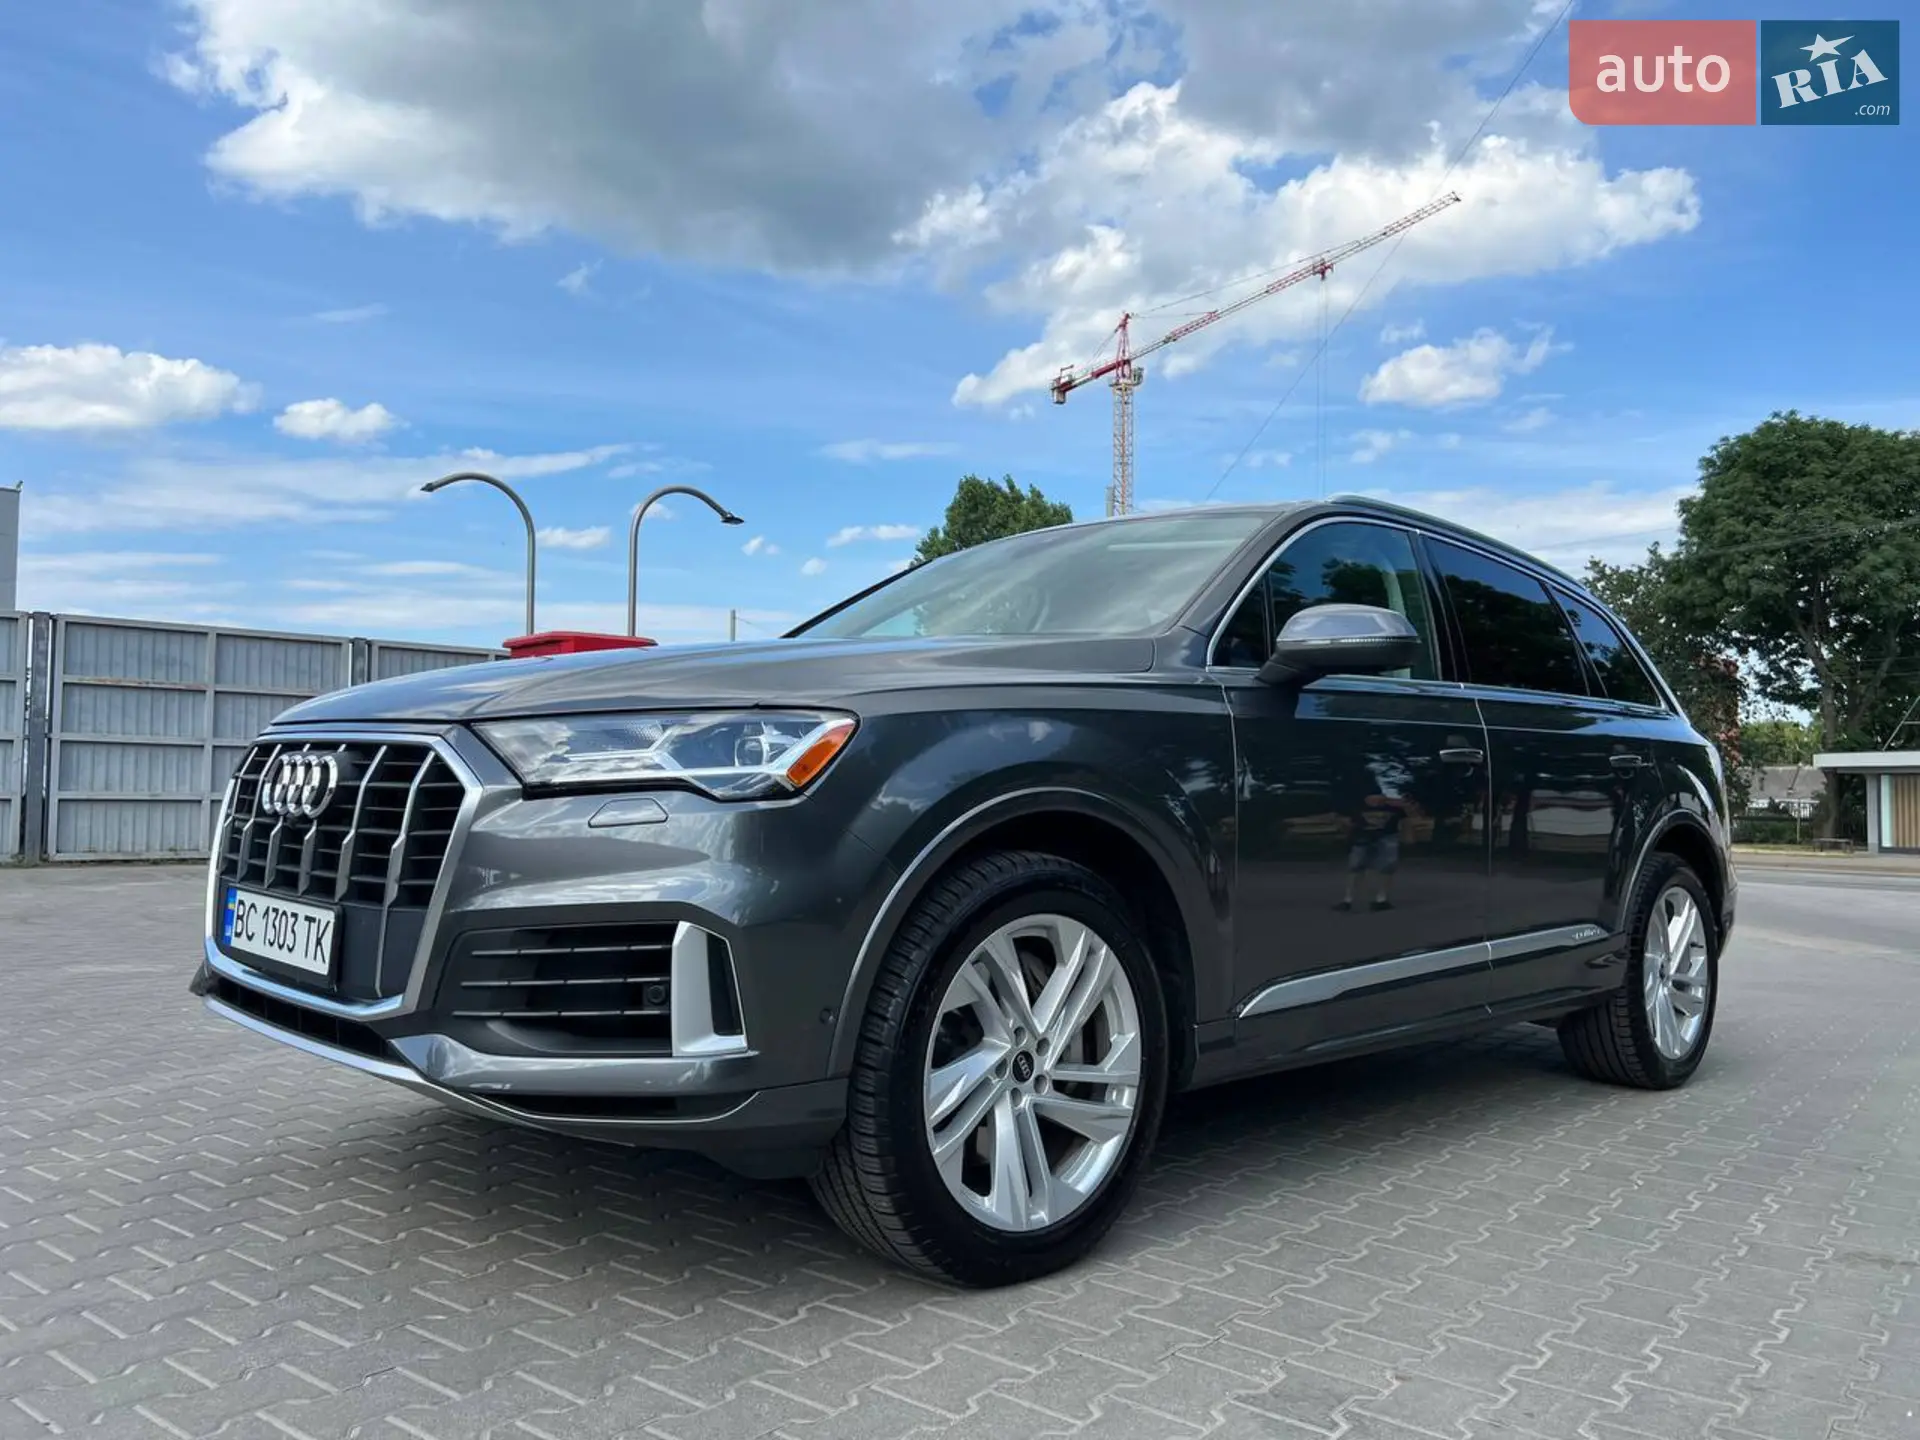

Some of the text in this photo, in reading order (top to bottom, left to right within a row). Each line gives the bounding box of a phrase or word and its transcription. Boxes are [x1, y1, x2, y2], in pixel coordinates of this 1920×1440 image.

[234, 899, 331, 964] BC 1303 TK
